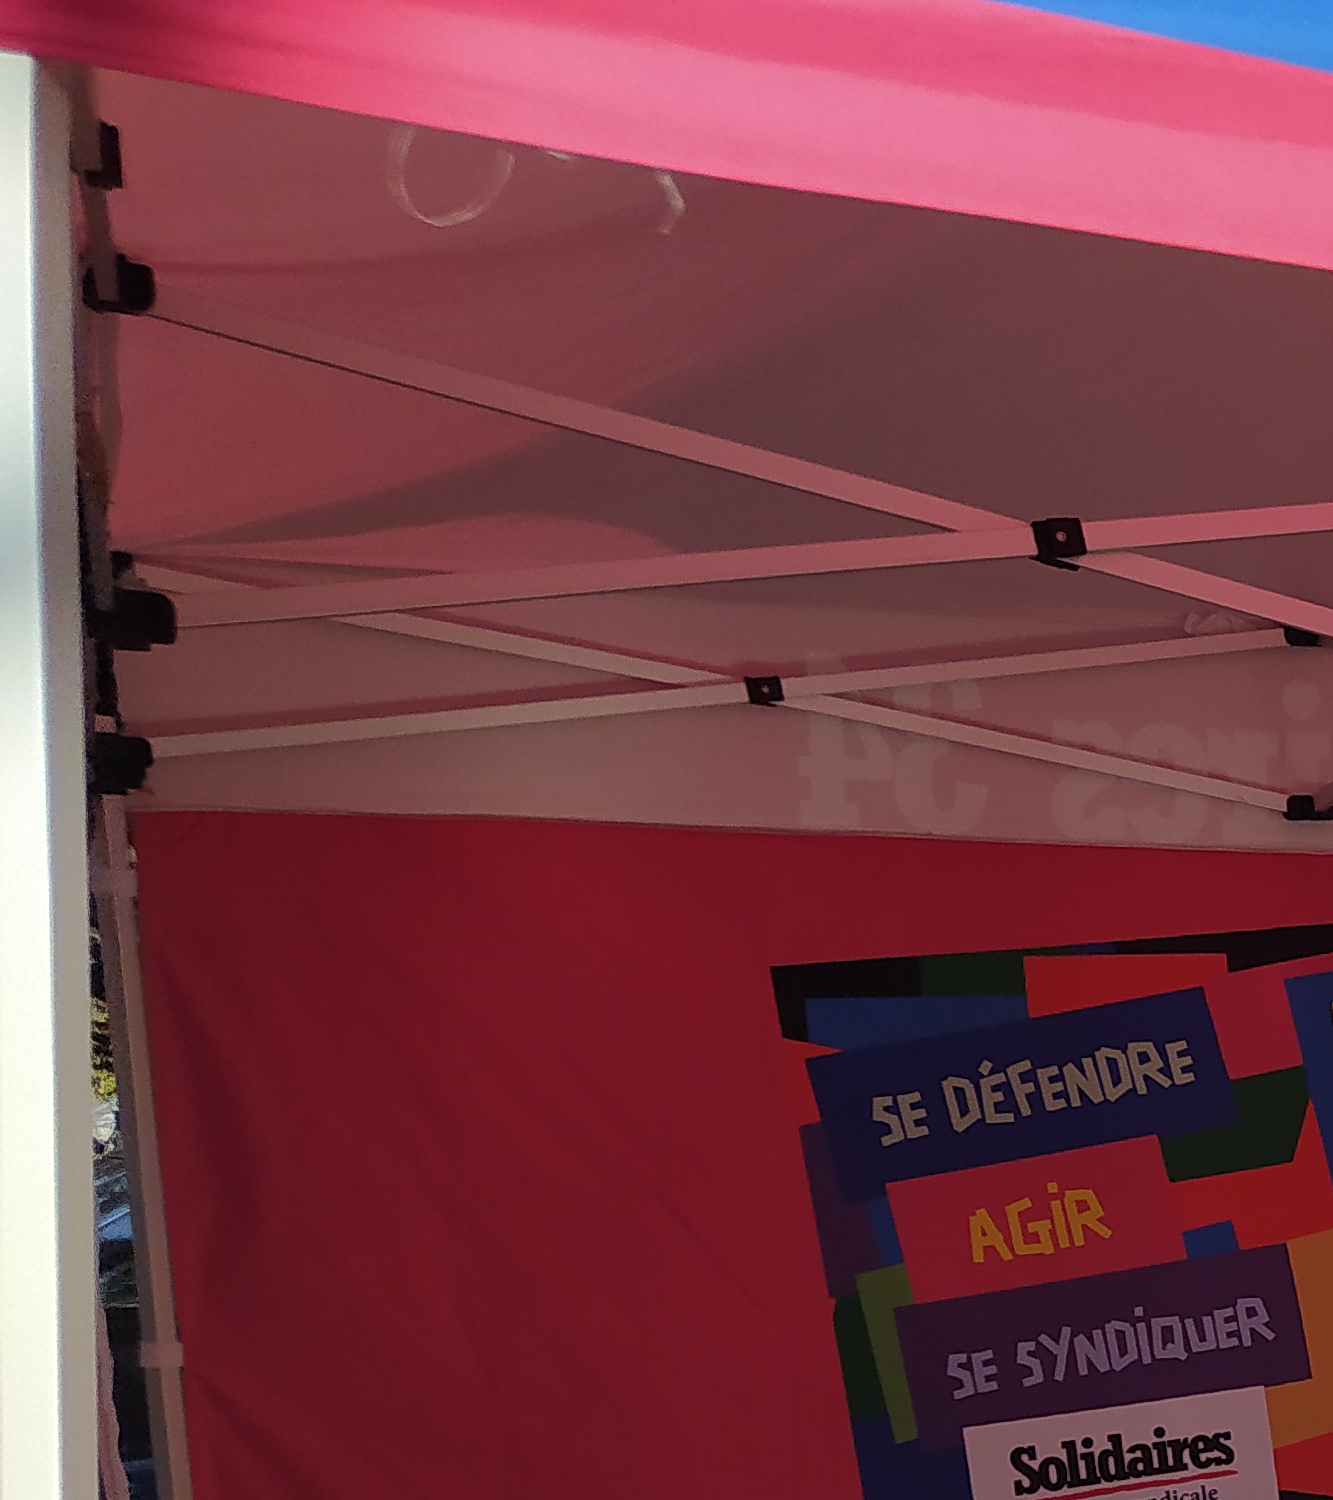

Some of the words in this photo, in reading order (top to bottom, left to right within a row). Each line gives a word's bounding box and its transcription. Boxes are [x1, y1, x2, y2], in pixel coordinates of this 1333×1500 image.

[870, 1093, 928, 1148] SE
[942, 1040, 1197, 1134] DÉFENDRE
[945, 1341, 1000, 1402] SE
[1010, 1424, 1234, 1497] Solidaires
